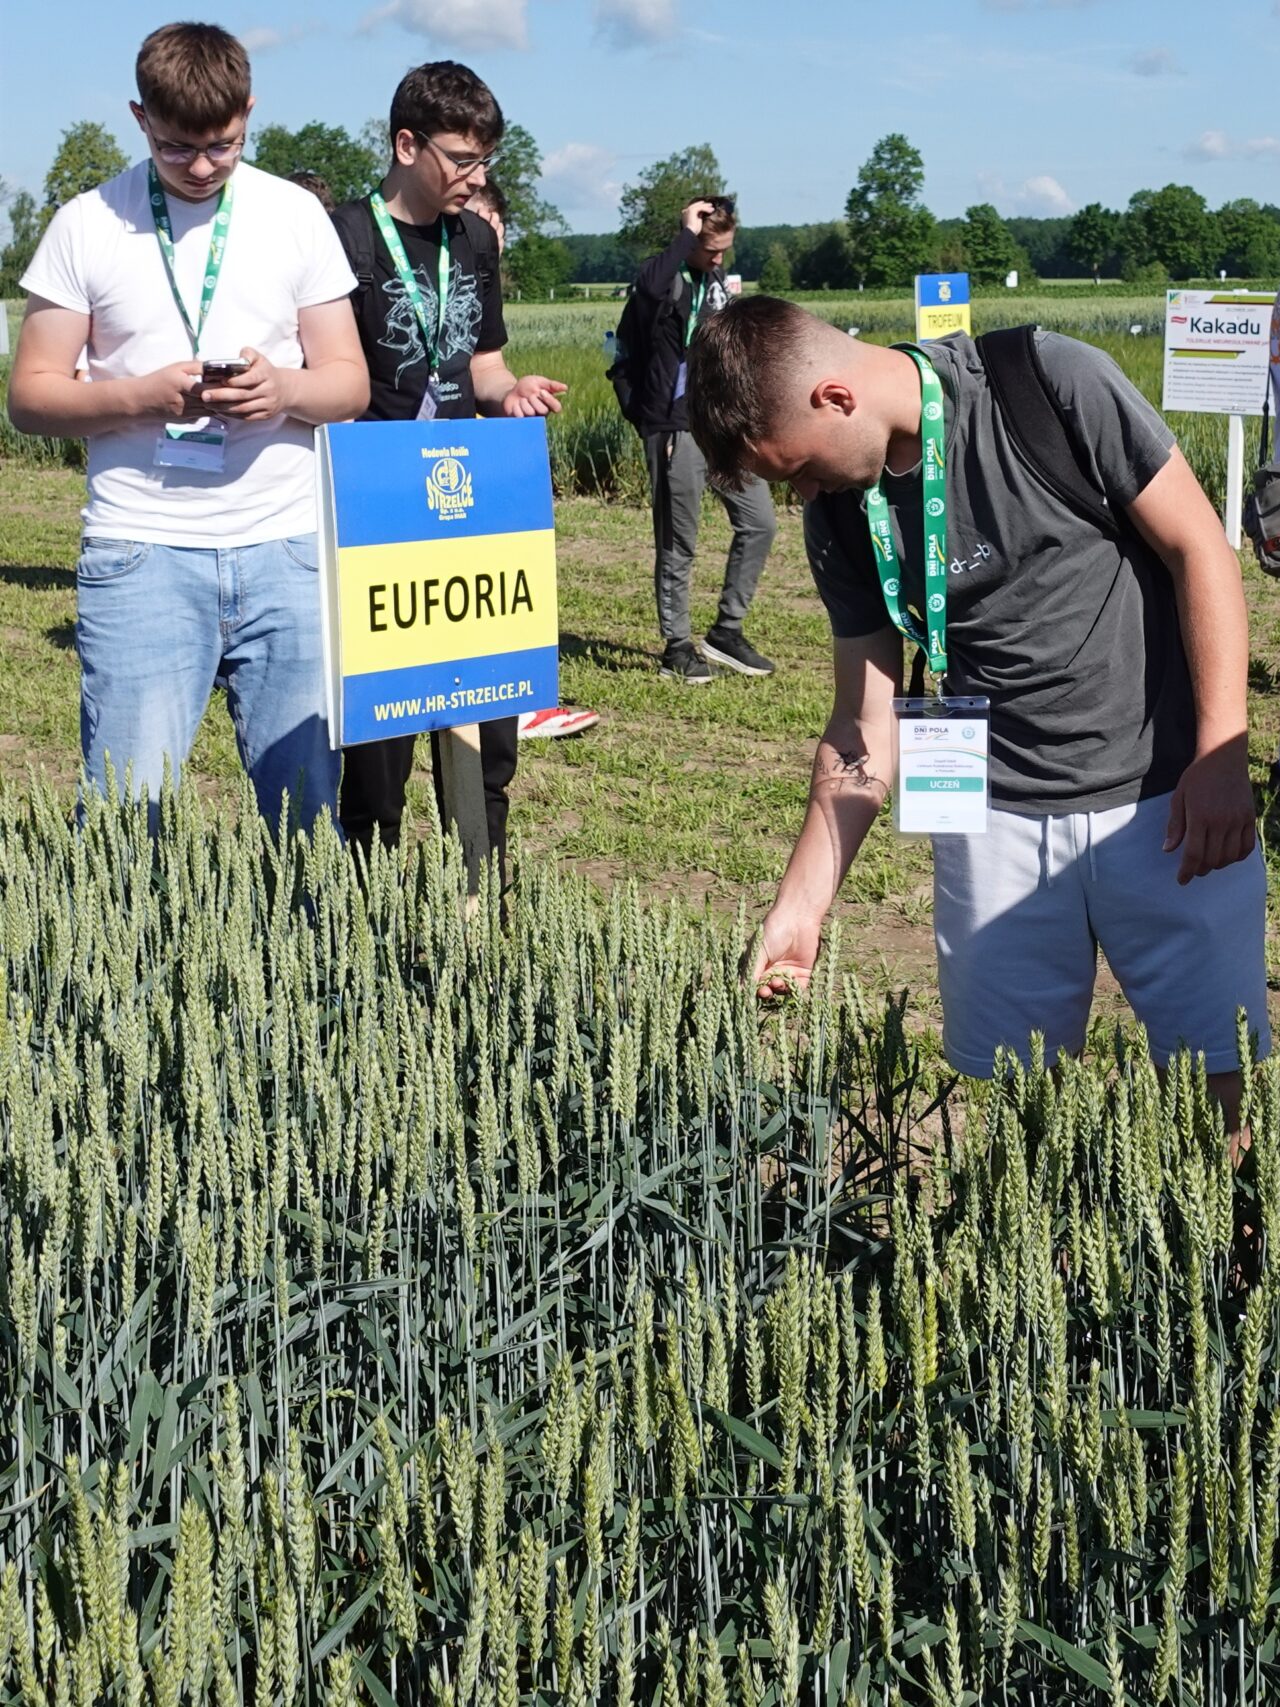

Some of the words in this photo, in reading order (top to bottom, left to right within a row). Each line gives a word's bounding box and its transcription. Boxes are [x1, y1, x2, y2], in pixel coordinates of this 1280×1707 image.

[1190, 317, 1260, 335] Kakadu
[926, 438, 935, 462] POLA
[426, 472, 475, 510] STRZELCE
[882, 536, 894, 562] POLA
[928, 534, 937, 559] POLA
[369, 569, 533, 632] EUFORIA
[374, 680, 534, 721] WWW.HR-STRZELCE.PL
[930, 779, 960, 789] UCZEŃ
